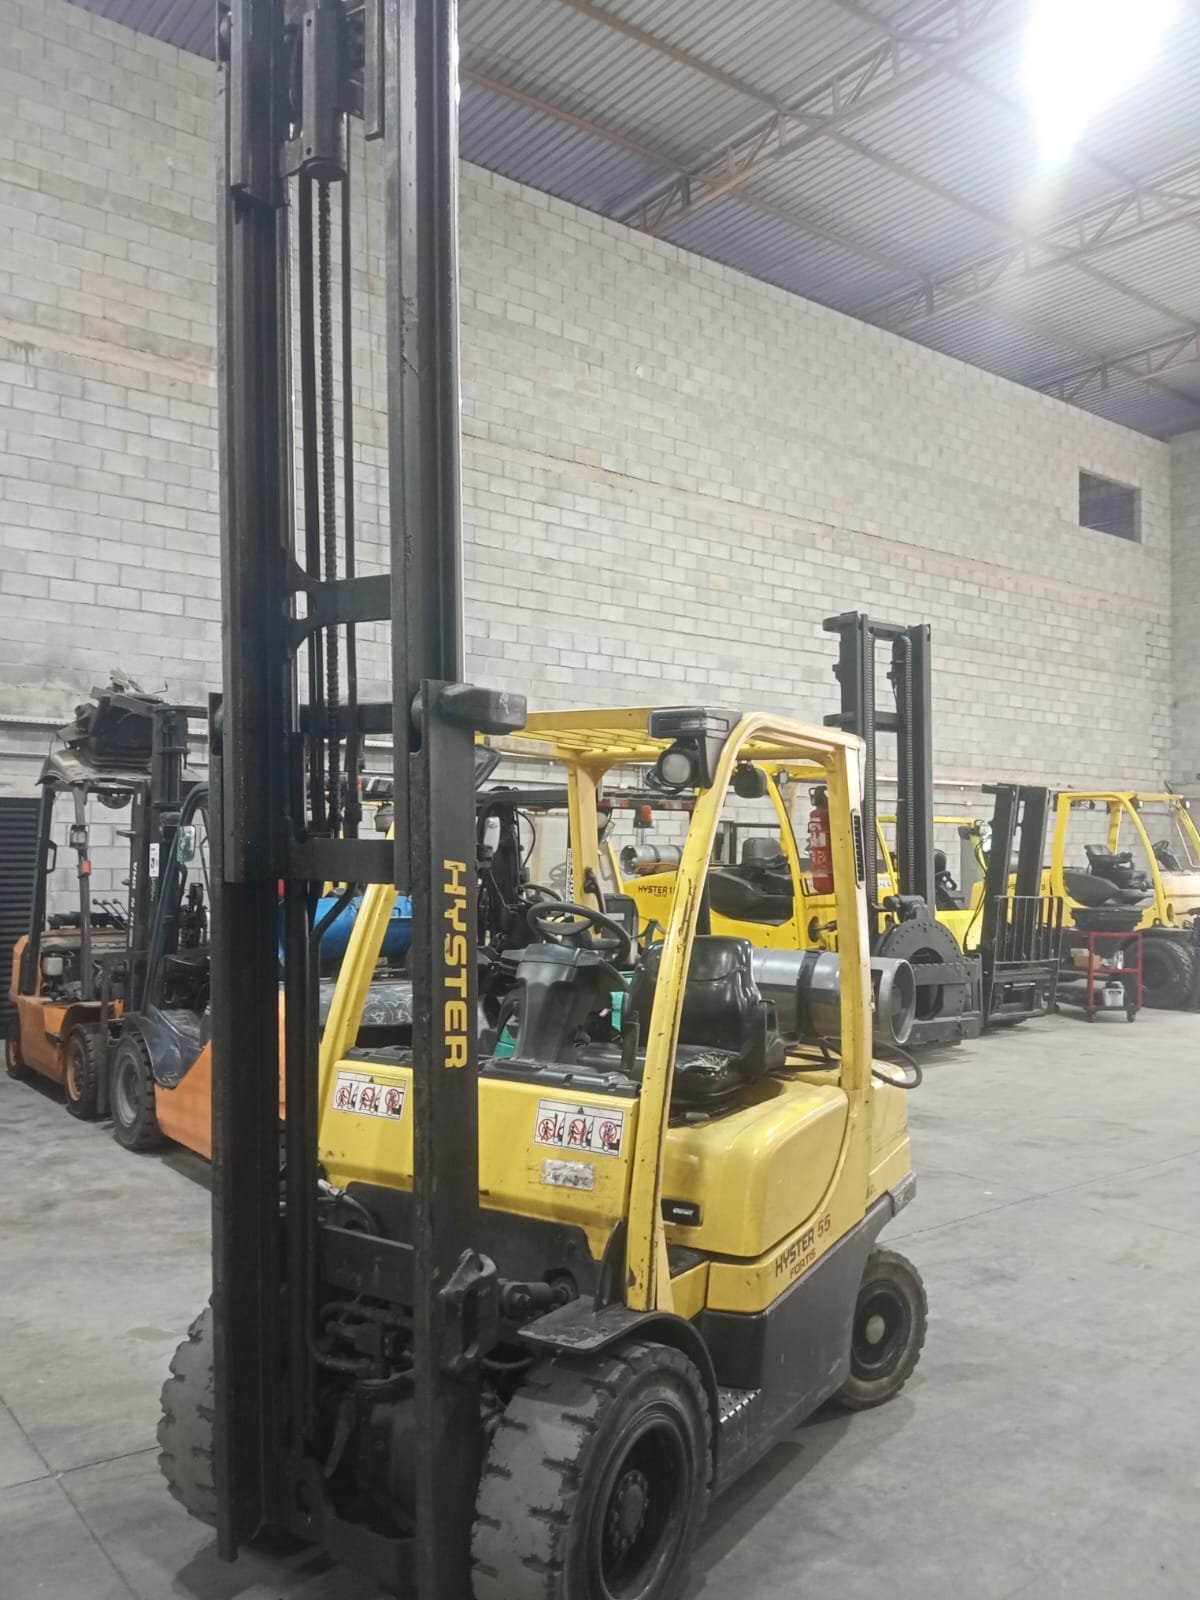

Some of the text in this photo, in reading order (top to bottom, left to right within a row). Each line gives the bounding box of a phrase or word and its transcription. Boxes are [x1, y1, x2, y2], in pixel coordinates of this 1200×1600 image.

[637, 884, 668, 895] HYSTER
[443, 859, 468, 1068] HYSTER
[775, 1213, 831, 1278] HYSTER 55
